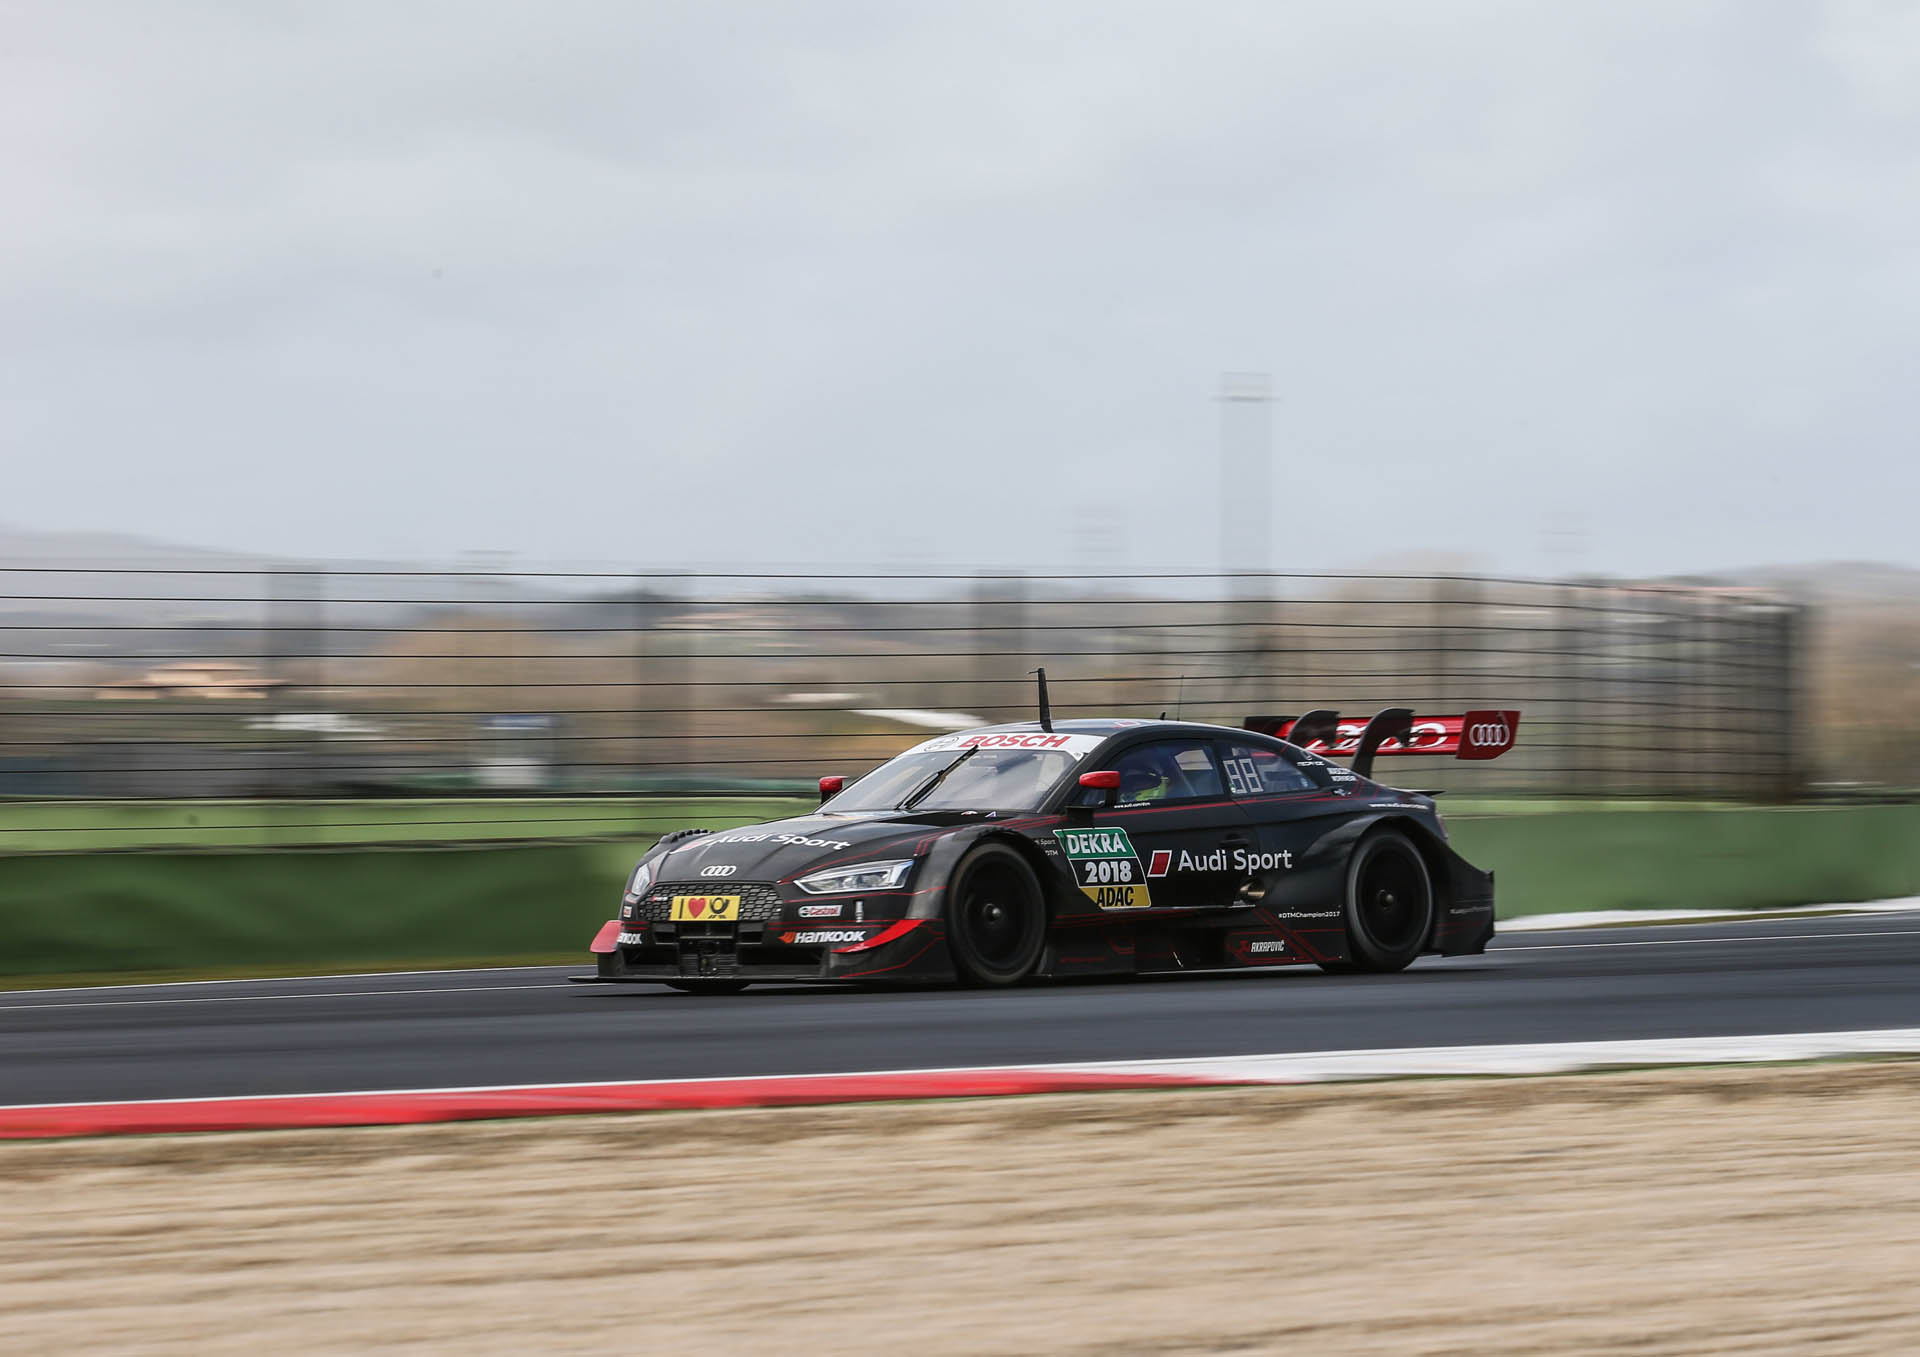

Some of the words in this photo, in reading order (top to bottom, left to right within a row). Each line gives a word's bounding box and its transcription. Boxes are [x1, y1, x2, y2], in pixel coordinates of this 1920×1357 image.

[959, 735, 1072, 748] BOSCH
[707, 833, 771, 847] Audi
[770, 833, 851, 850] Sport
[1066, 833, 1127, 854] DEKRA
[1085, 860, 1132, 883] 2018
[1177, 849, 1228, 872] Audi
[1233, 848, 1293, 876] Sport
[1096, 886, 1134, 906] ADAC
